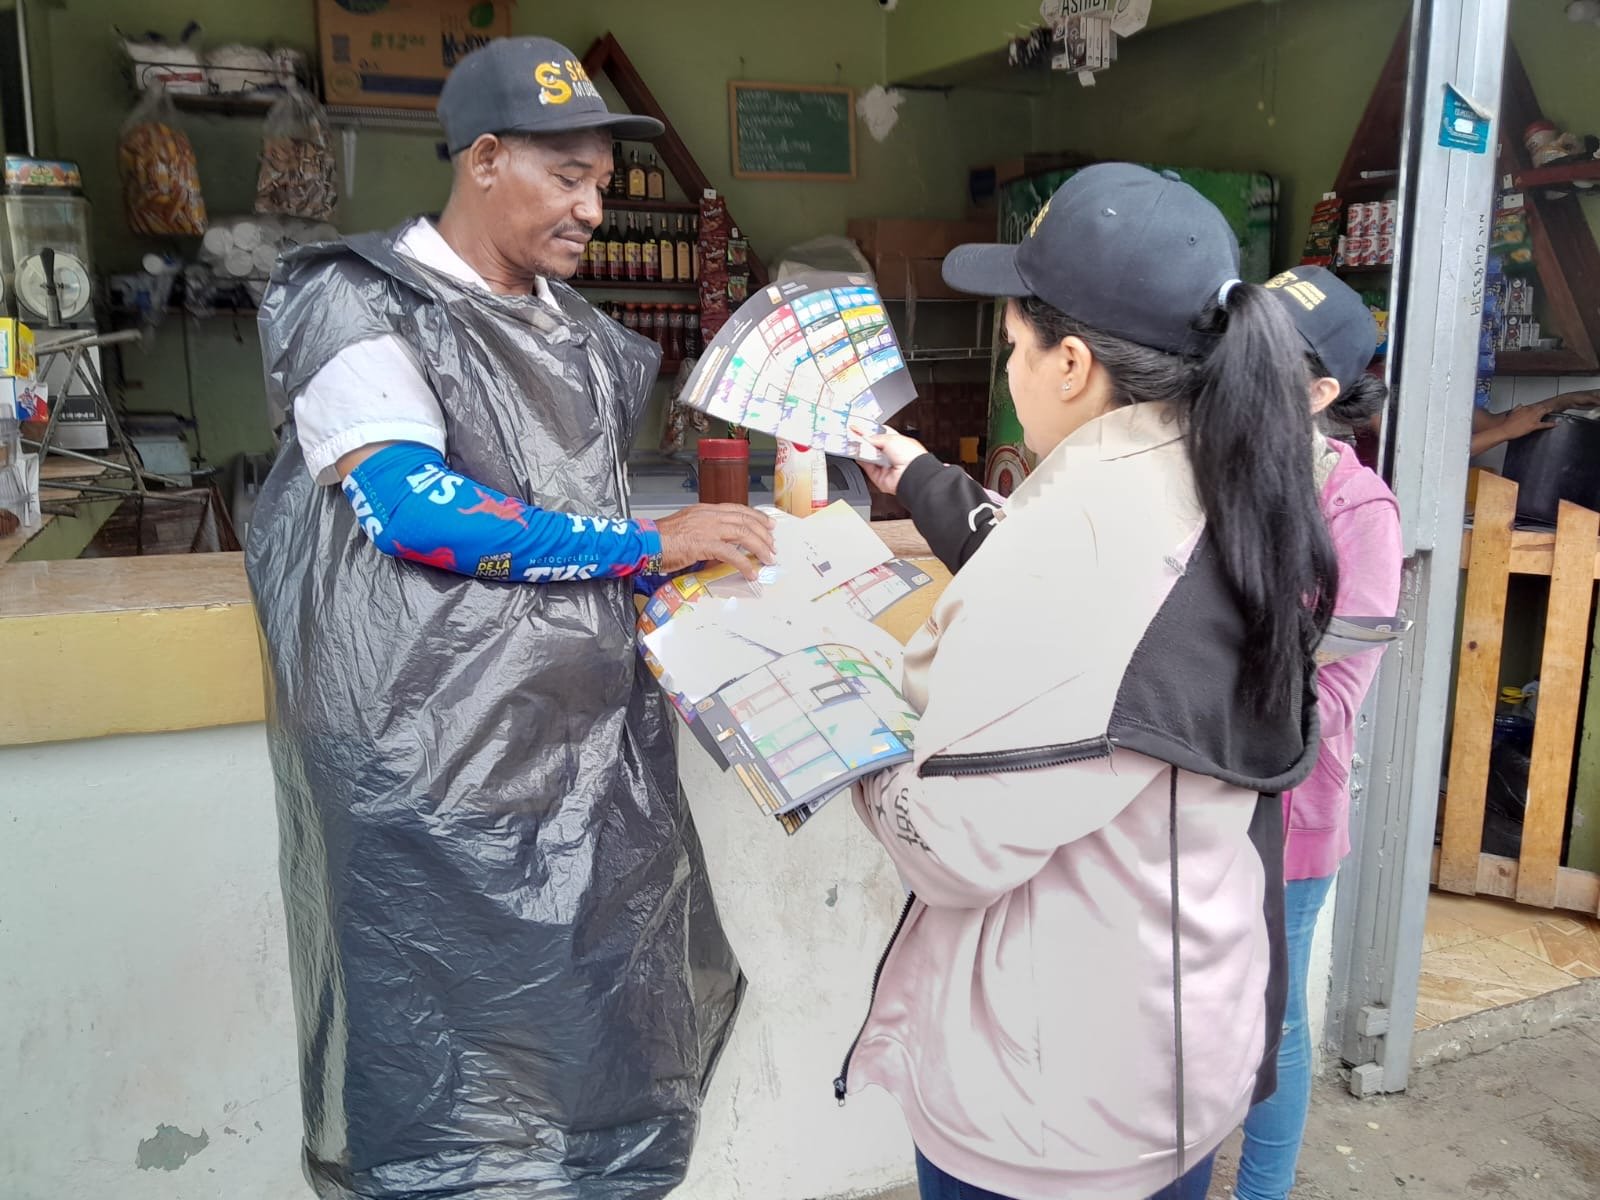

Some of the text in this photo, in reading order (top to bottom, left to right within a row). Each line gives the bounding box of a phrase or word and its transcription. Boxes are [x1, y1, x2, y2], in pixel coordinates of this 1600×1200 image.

[566, 512, 629, 536] TVS
[475, 568, 510, 577] INDIA
[478, 559, 510, 571] DE LA
[522, 563, 599, 584] TVS
